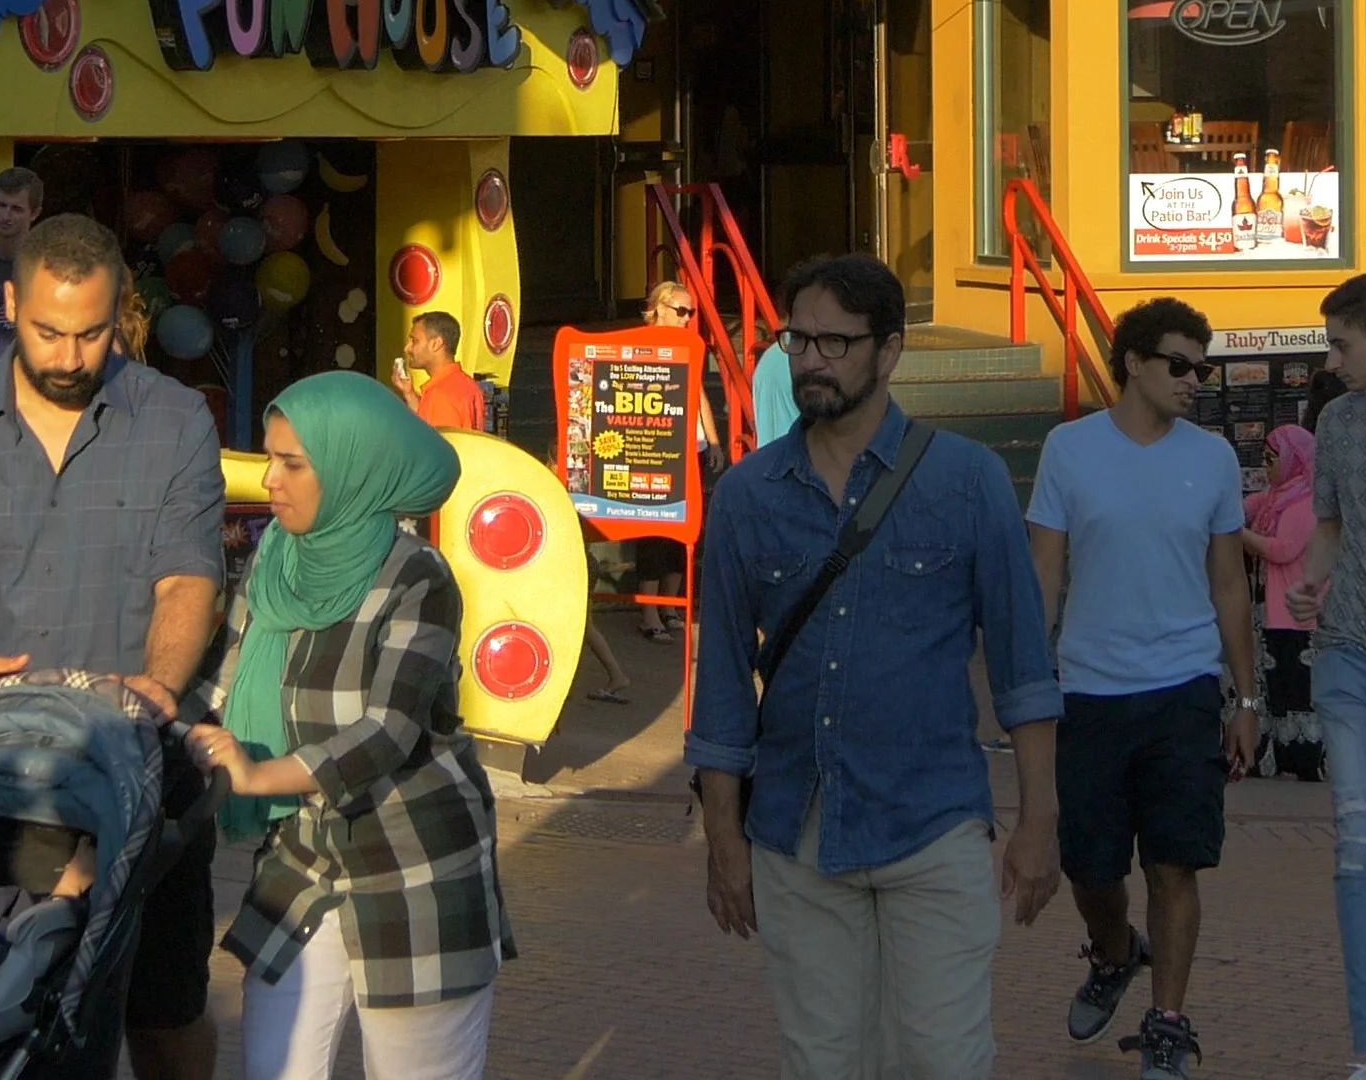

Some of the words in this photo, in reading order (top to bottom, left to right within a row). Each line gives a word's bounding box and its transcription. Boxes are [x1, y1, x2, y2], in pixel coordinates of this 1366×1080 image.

[1179, 0, 1282, 30] OPEN
[1159, 188, 1187, 201] Join
[1188, 188, 1203, 200] Us
[1151, 210, 1183, 222] Patio
[1187, 210, 1212, 222] Bar!
[1136, 233, 1161, 244] Drink
[1162, 233, 1197, 245] Specials
[1225, 330, 1329, 351] RubyTuesda
[595, 401, 614, 413] The
[615, 391, 663, 415] BIG
[664, 403, 684, 416] Fun
[607, 415, 644, 426] VALUE
[646, 416, 673, 427] PASS
[607, 507, 635, 517] Purchase
[637, 508, 659, 518] Tickets
